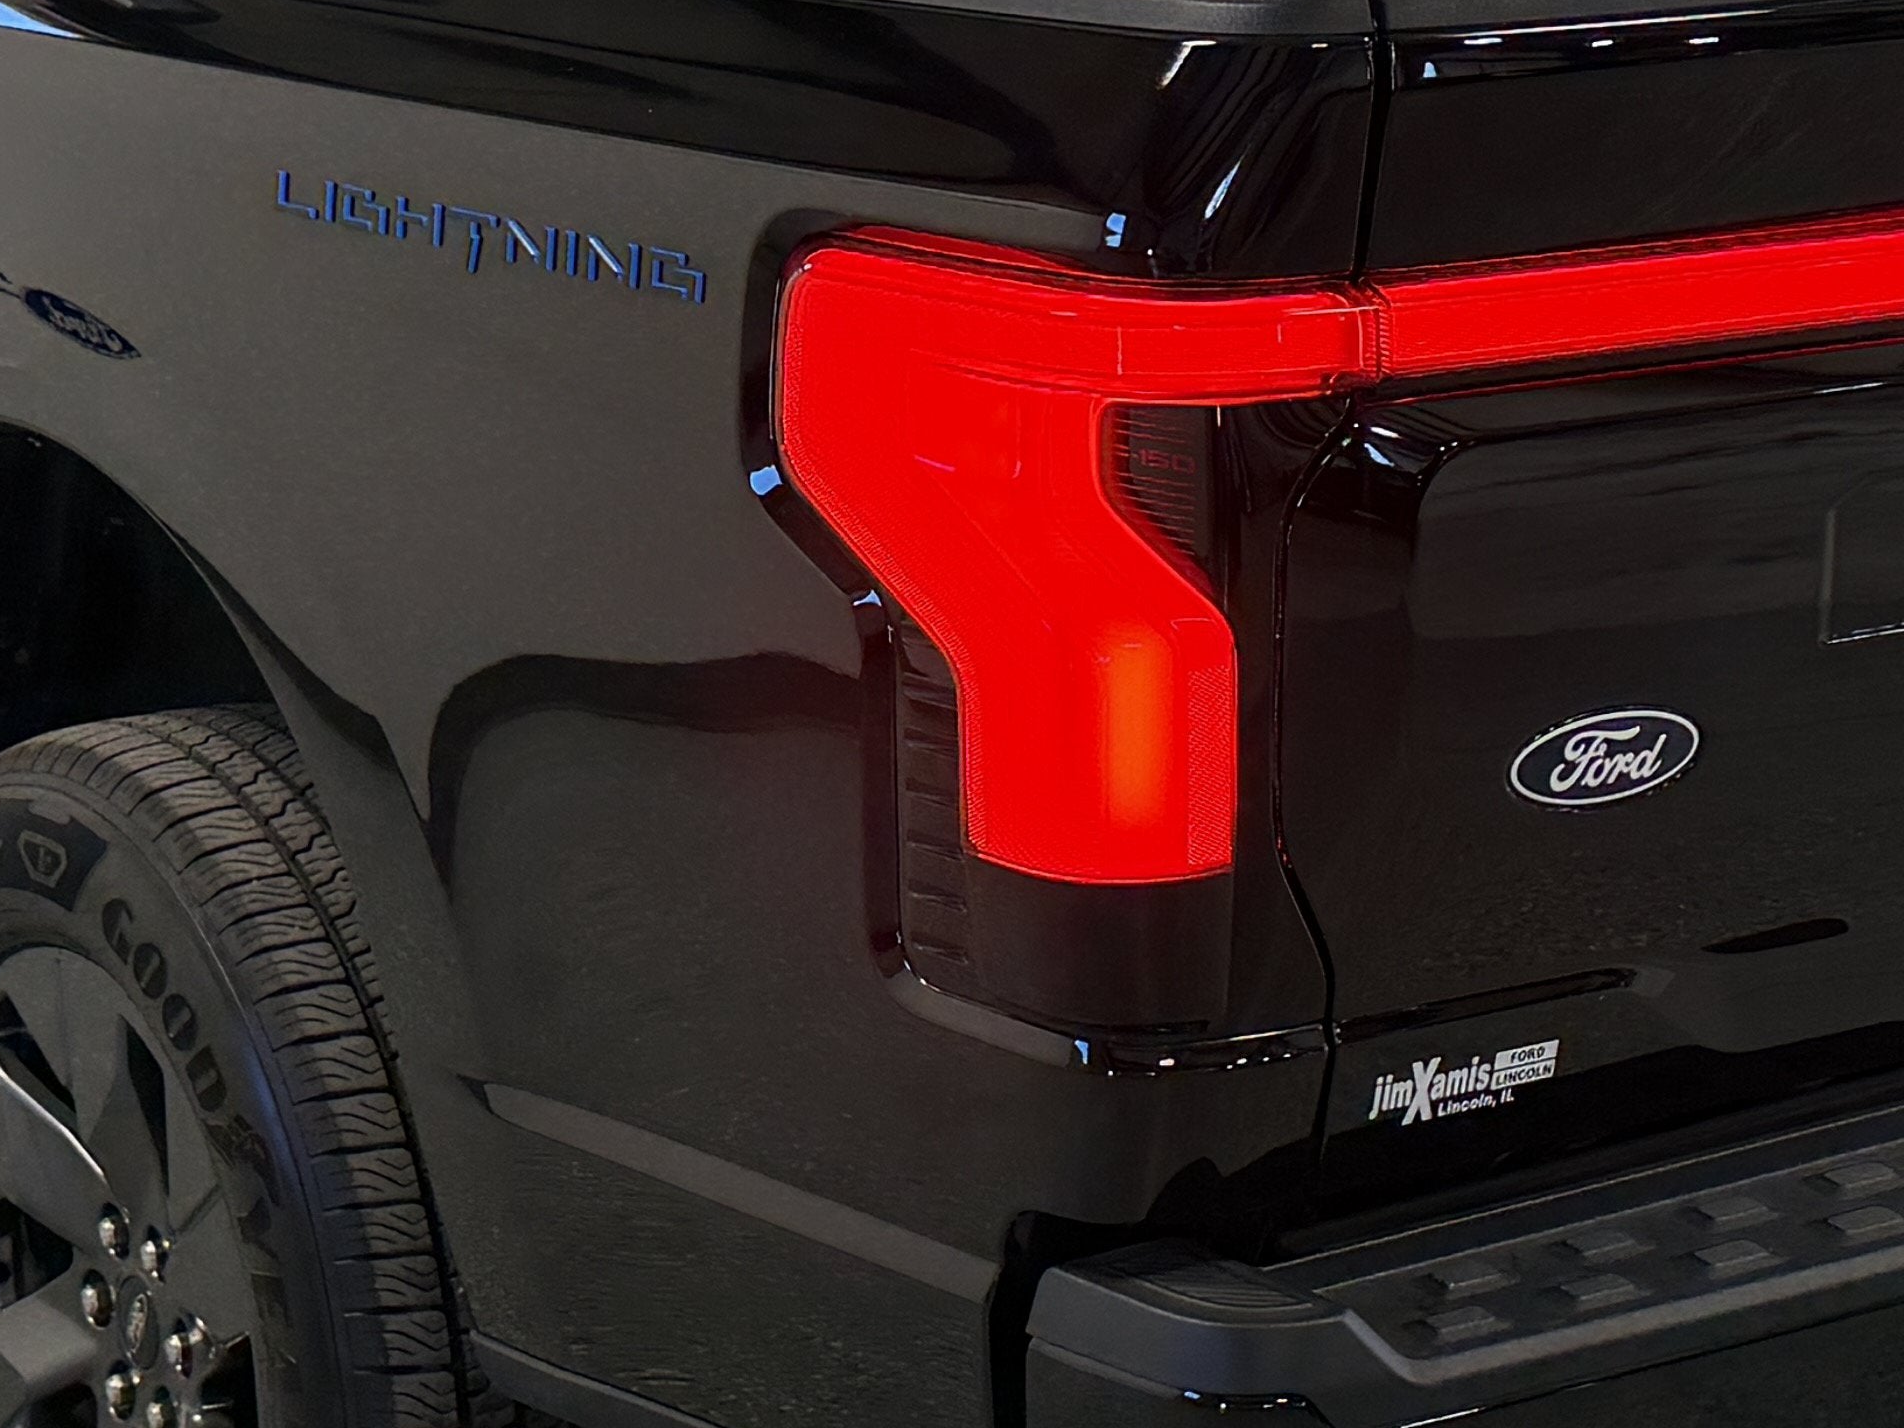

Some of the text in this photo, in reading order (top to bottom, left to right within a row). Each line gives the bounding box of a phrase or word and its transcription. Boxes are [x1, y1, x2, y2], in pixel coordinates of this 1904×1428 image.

[277, 169, 705, 304] LIGHTNING
[1549, 725, 1667, 792] Ford
[1496, 1064, 1553, 1086] LINCOLN
[1510, 1045, 1546, 1064] FORD
